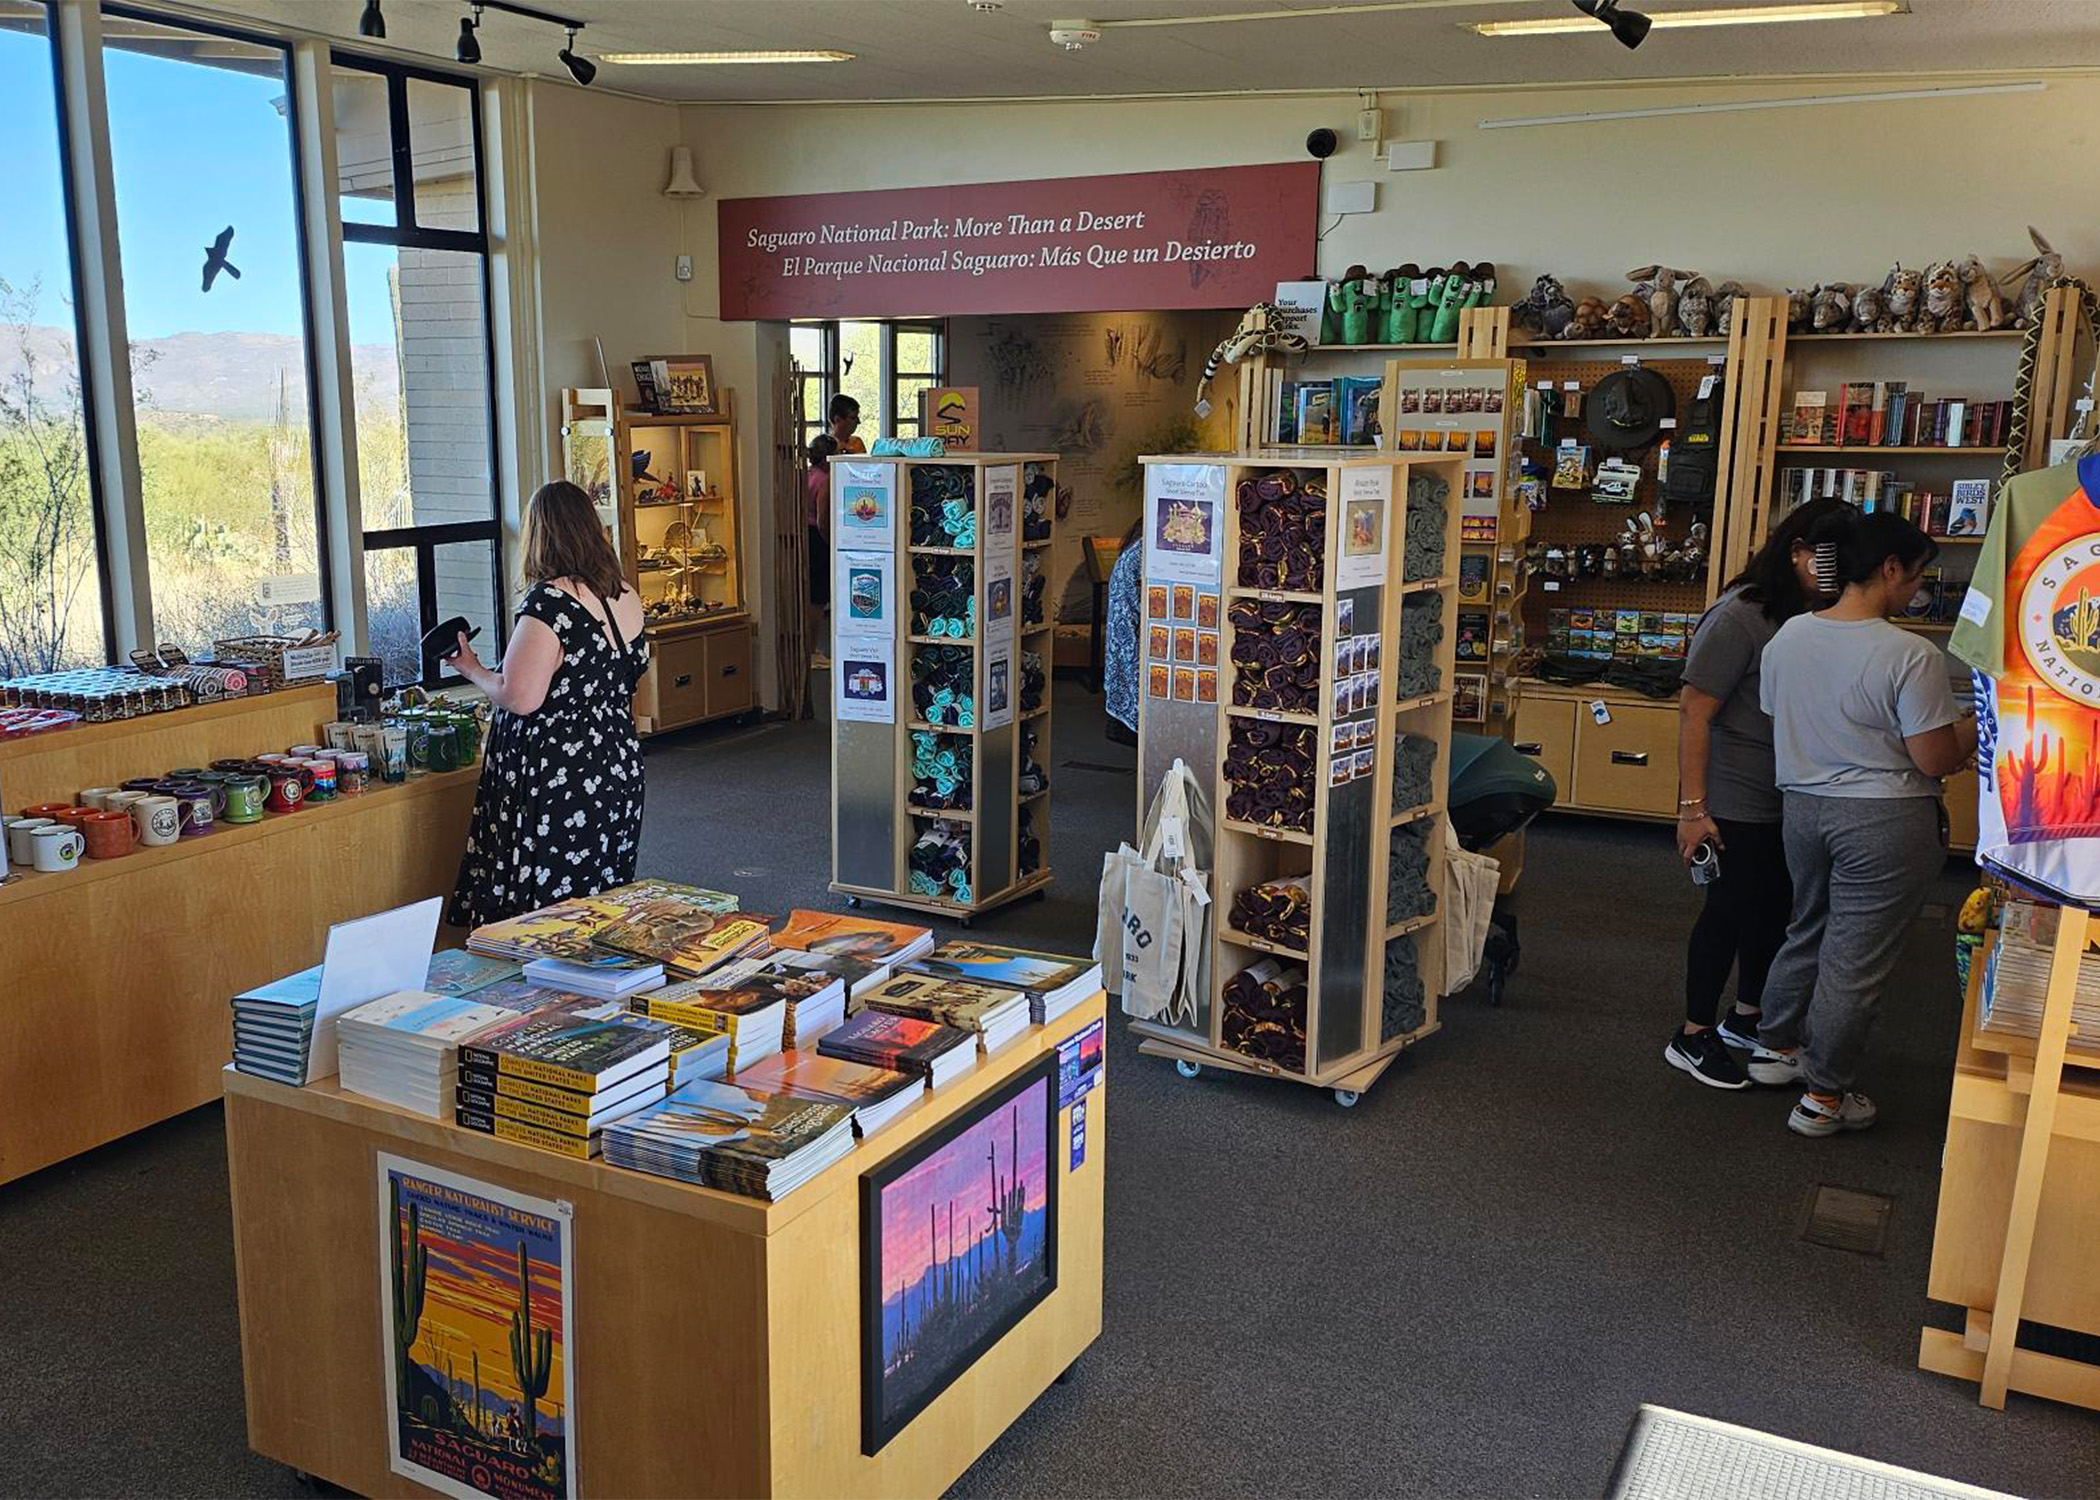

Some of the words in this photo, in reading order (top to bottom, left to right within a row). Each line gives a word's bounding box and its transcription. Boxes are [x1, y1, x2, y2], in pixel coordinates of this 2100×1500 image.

[747, 228, 816, 252] Saguaro
[819, 220, 898, 245] National
[901, 217, 949, 240] Park:
[953, 216, 1002, 238] More
[1007, 213, 1055, 235] Than
[1060, 218, 1072, 233] a
[1076, 210, 1145, 232] Desert
[782, 256, 800, 277] El
[804, 256, 863, 280] Parque
[867, 250, 948, 274] Nacional
[951, 248, 1035, 276] Saguaro:
[1039, 245, 1081, 267] Más
[1086, 244, 1128, 268] Que
[1133, 249, 1159, 263] un
[1164, 239, 1256, 262] Desierto
[1280, 306, 1318, 314] urchases
[935, 425, 970, 435] SUN
[1956, 496, 1985, 504] WEST
[1957, 489, 1986, 497] BIRDS
[2036, 639, 2100, 697] NATIO
[523, 1069, 548, 1080] UNITED
[548, 1073, 571, 1085] STATES
[533, 1064, 567, 1077] NATIONAL
[567, 1072, 588, 1082] PARKS
[521, 1090, 544, 1101] UNITED
[544, 1095, 566, 1107] STATES
[530, 1085, 561, 1098] NATIONAL
[562, 1093, 581, 1104] PARKS
[518, 1111, 541, 1123] UNITED
[541, 1116, 563, 1128] STATES
[527, 1105, 558, 1119] NATIONAL
[559, 1114, 579, 1125] PARKS
[518, 1134, 541, 1145] UNITED
[541, 1138, 563, 1150] STATES
[527, 1127, 558, 1141] NATIONAL
[559, 1136, 579, 1148] PARKS
[403, 1176, 443, 1197] RANGER
[445, 1188, 505, 1216] NATURALIST
[508, 1209, 555, 1232] SERVICE
[434, 1432, 530, 1480] SAGUARO
[410, 1437, 467, 1467] NATIONAL
[494, 1471, 556, 1500] MONUMENT
